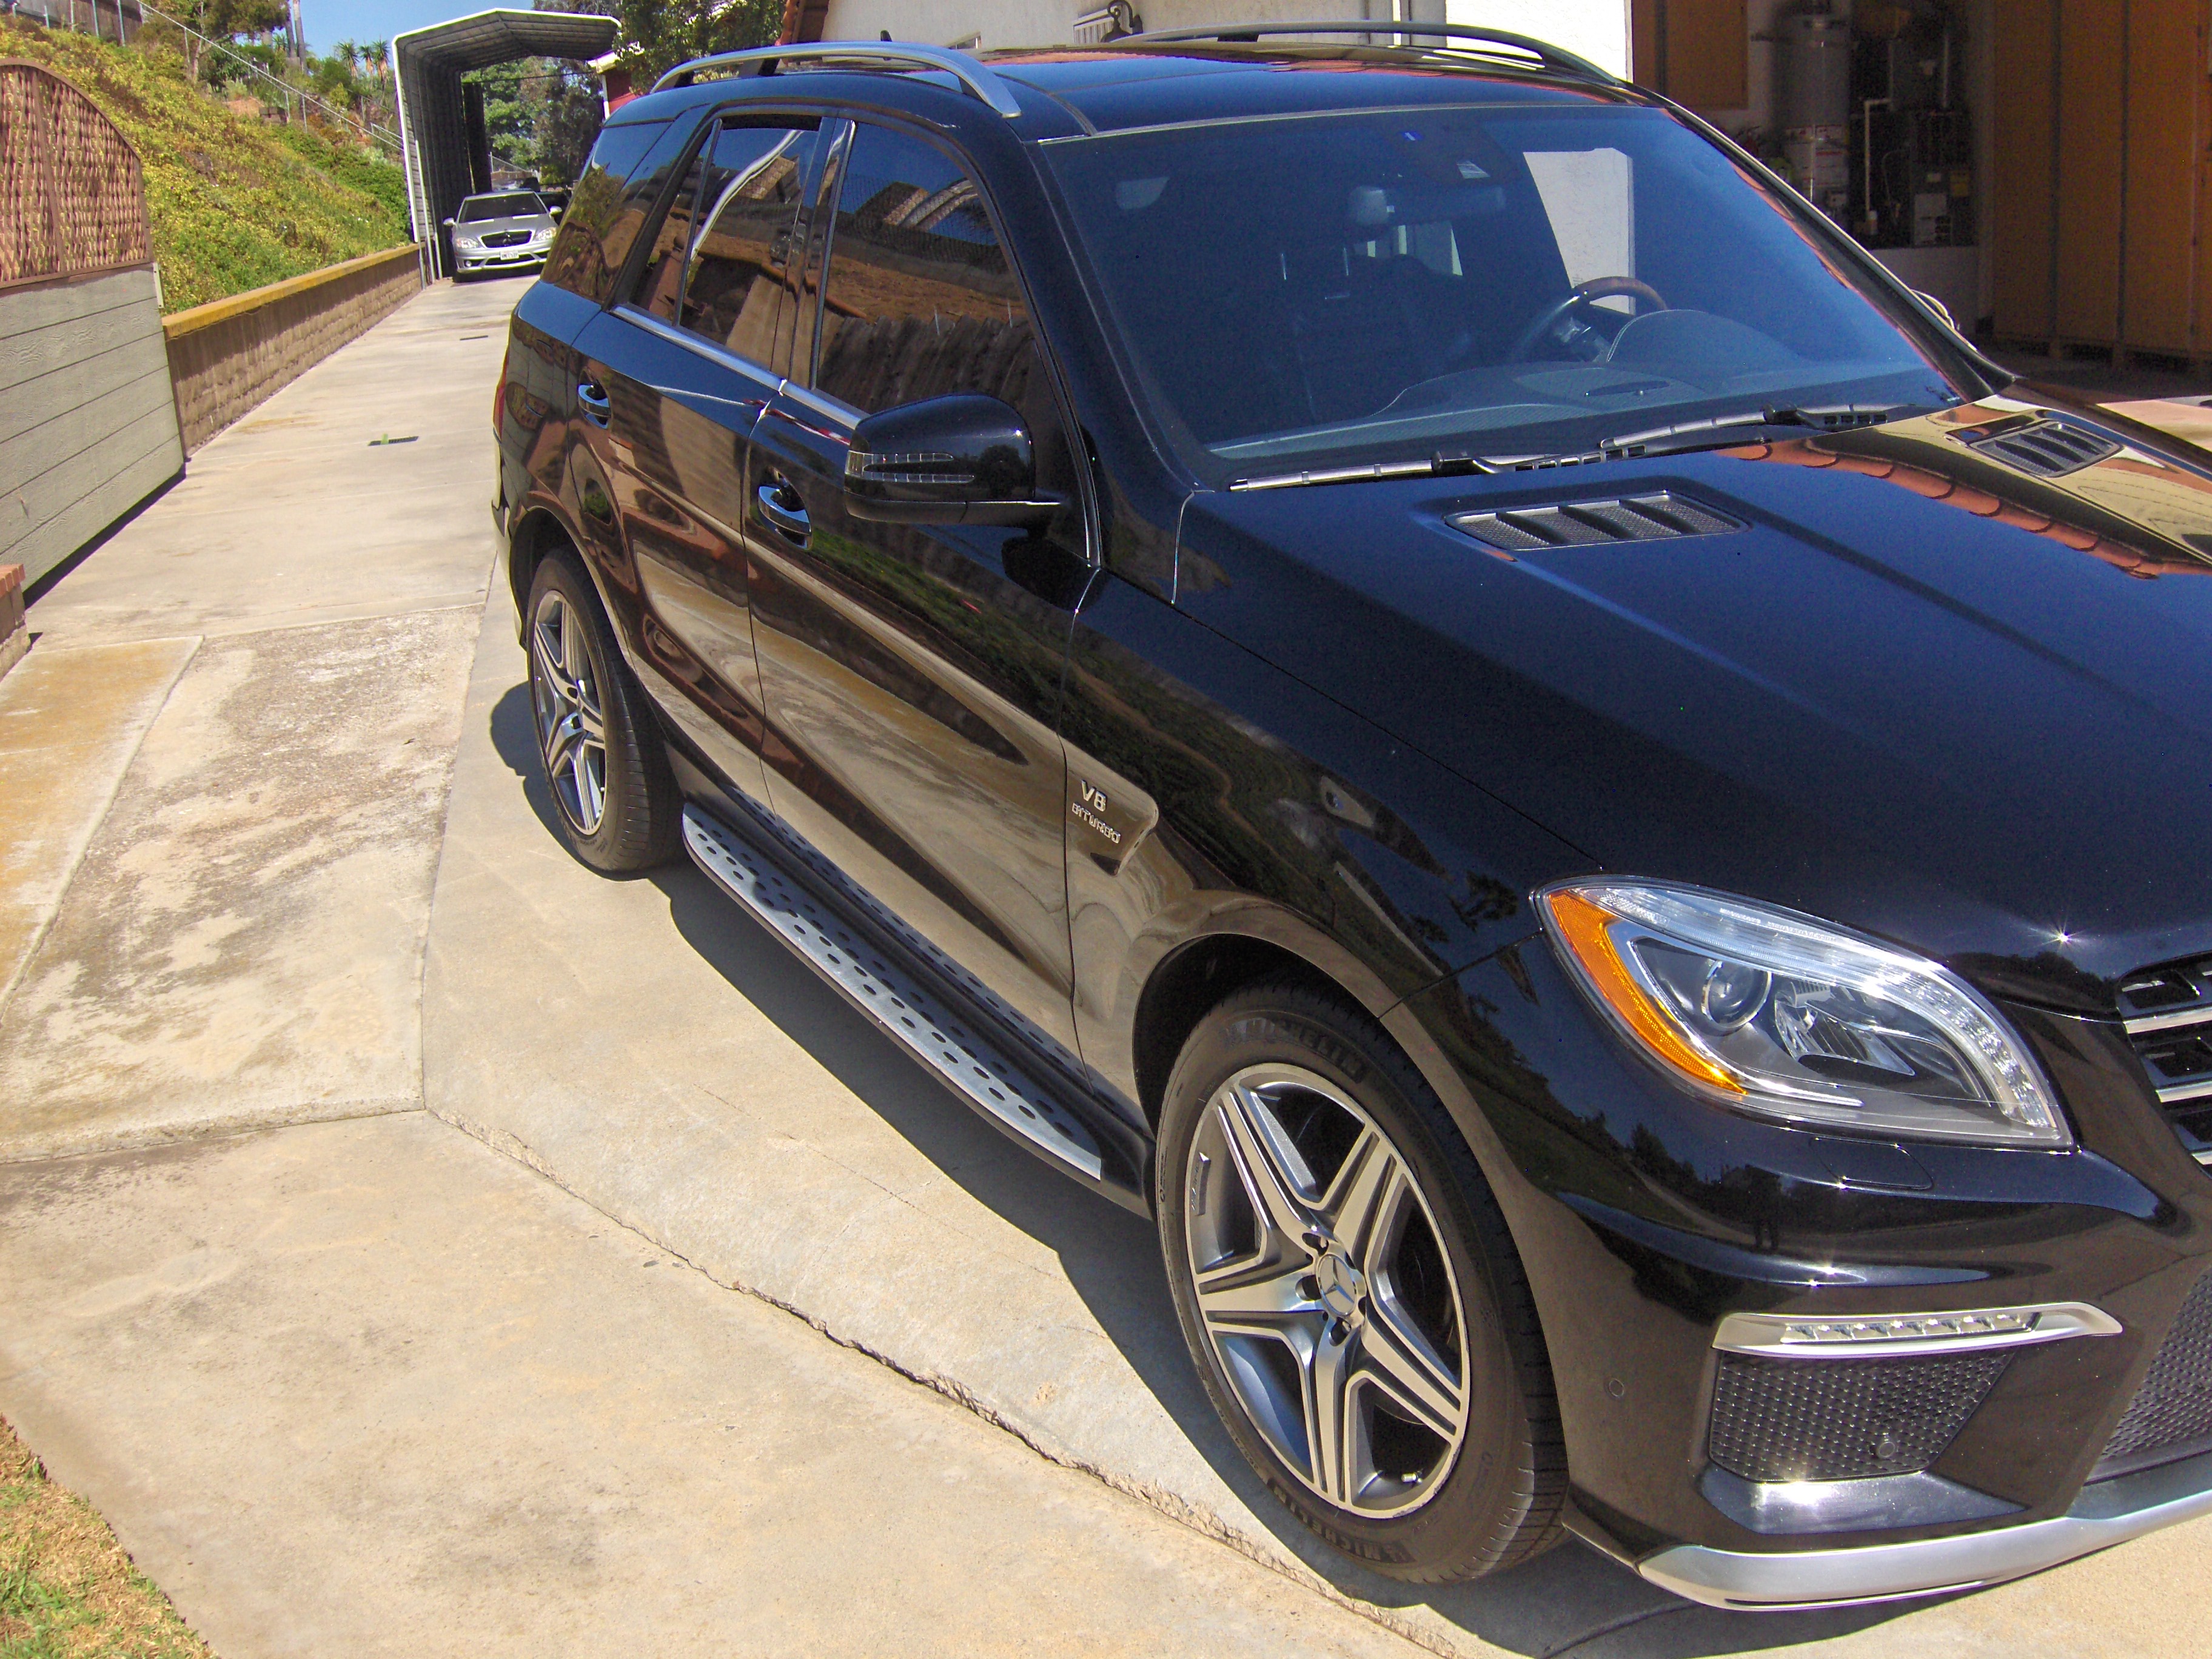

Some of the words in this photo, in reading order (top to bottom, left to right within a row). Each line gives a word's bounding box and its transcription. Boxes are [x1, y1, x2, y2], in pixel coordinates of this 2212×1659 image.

[1081, 780, 1107, 812] V8
[1071, 802, 1121, 844] BITURBO
[1274, 1486, 1381, 1560] MICHELIN
